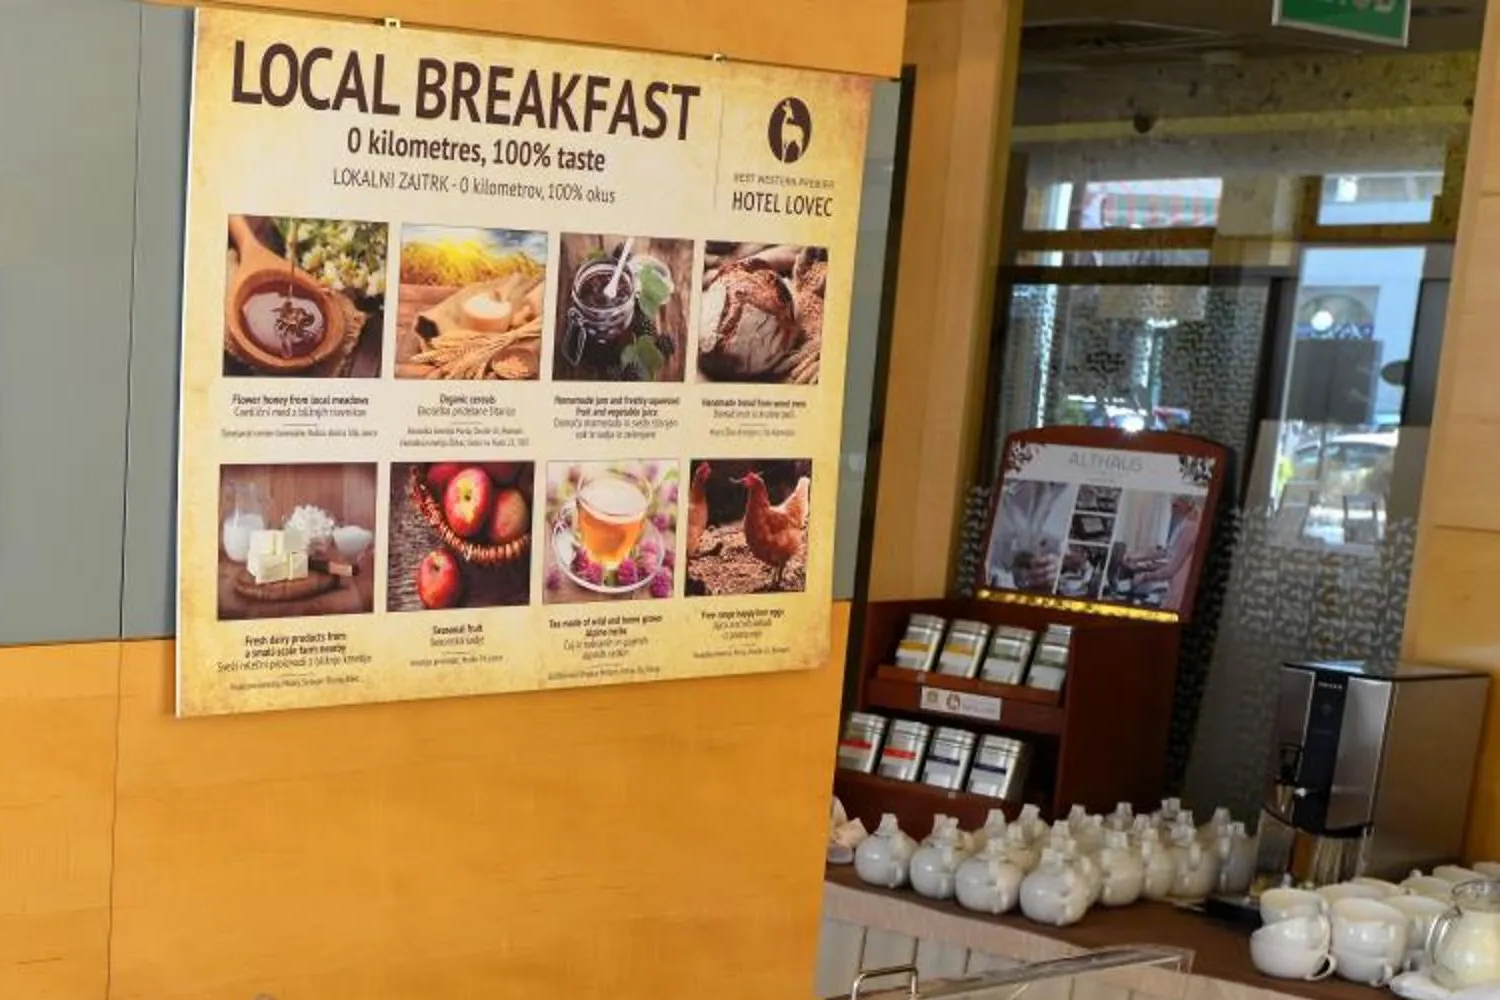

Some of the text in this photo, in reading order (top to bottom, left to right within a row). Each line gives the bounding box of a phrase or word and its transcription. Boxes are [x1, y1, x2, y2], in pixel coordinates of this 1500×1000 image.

[231, 39, 702, 142] LOCAL BREAKFAST
[347, 128, 607, 172] 0 kilometres, 100% taste
[333, 167, 395, 189] LOKALNI
[399, 172, 450, 193] ZAJTRK
[472, 176, 544, 201] kilometrov,
[547, 182, 583, 201] 100%
[586, 187, 616, 205] okus
[731, 191, 834, 217] HOTEL LOVEC
[289, 393, 309, 405] from
[1068, 451, 1144, 472] ALTHAUS
[245, 631, 347, 647] Fresh dairy products from
